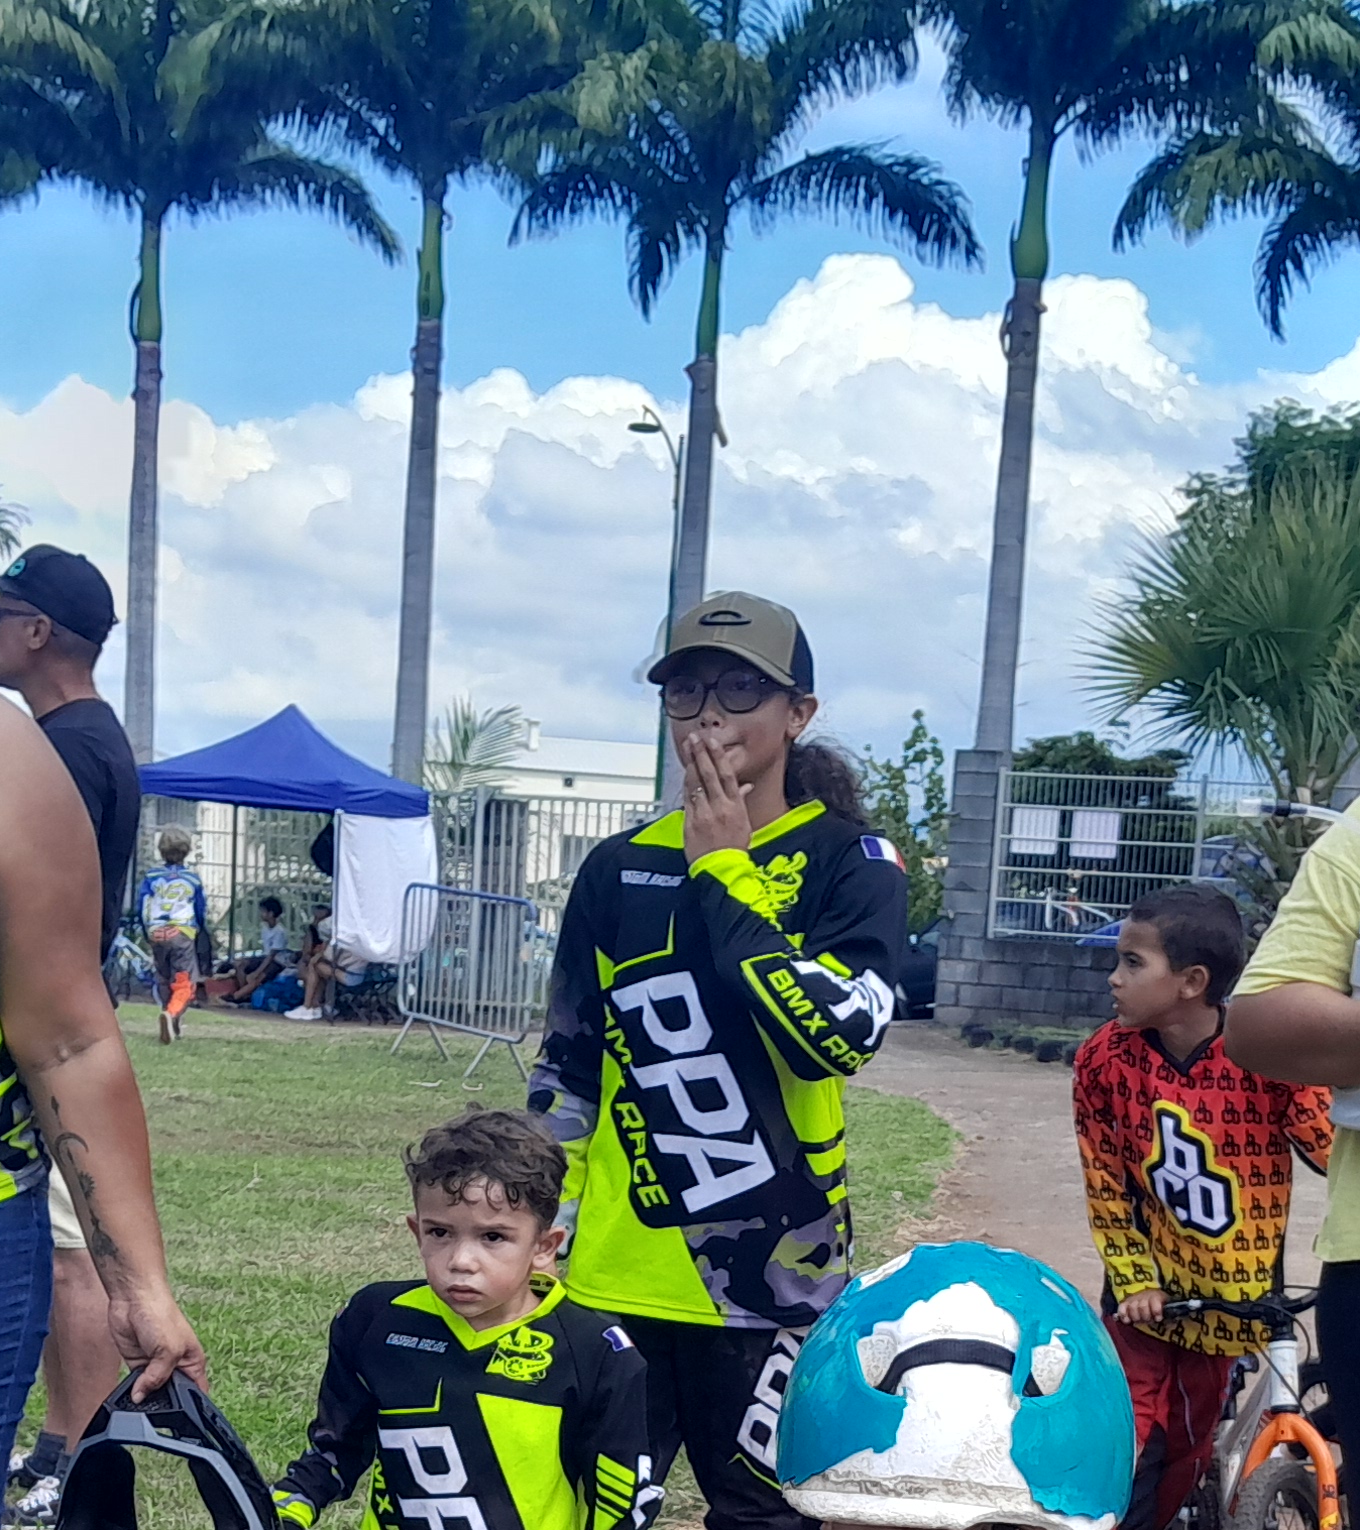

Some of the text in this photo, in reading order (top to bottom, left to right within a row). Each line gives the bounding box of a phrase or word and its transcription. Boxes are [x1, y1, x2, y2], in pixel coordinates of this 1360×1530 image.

[766, 968, 829, 1036] BMX
[611, 970, 777, 1214] PPA
[614, 1102, 671, 1209] RACE
